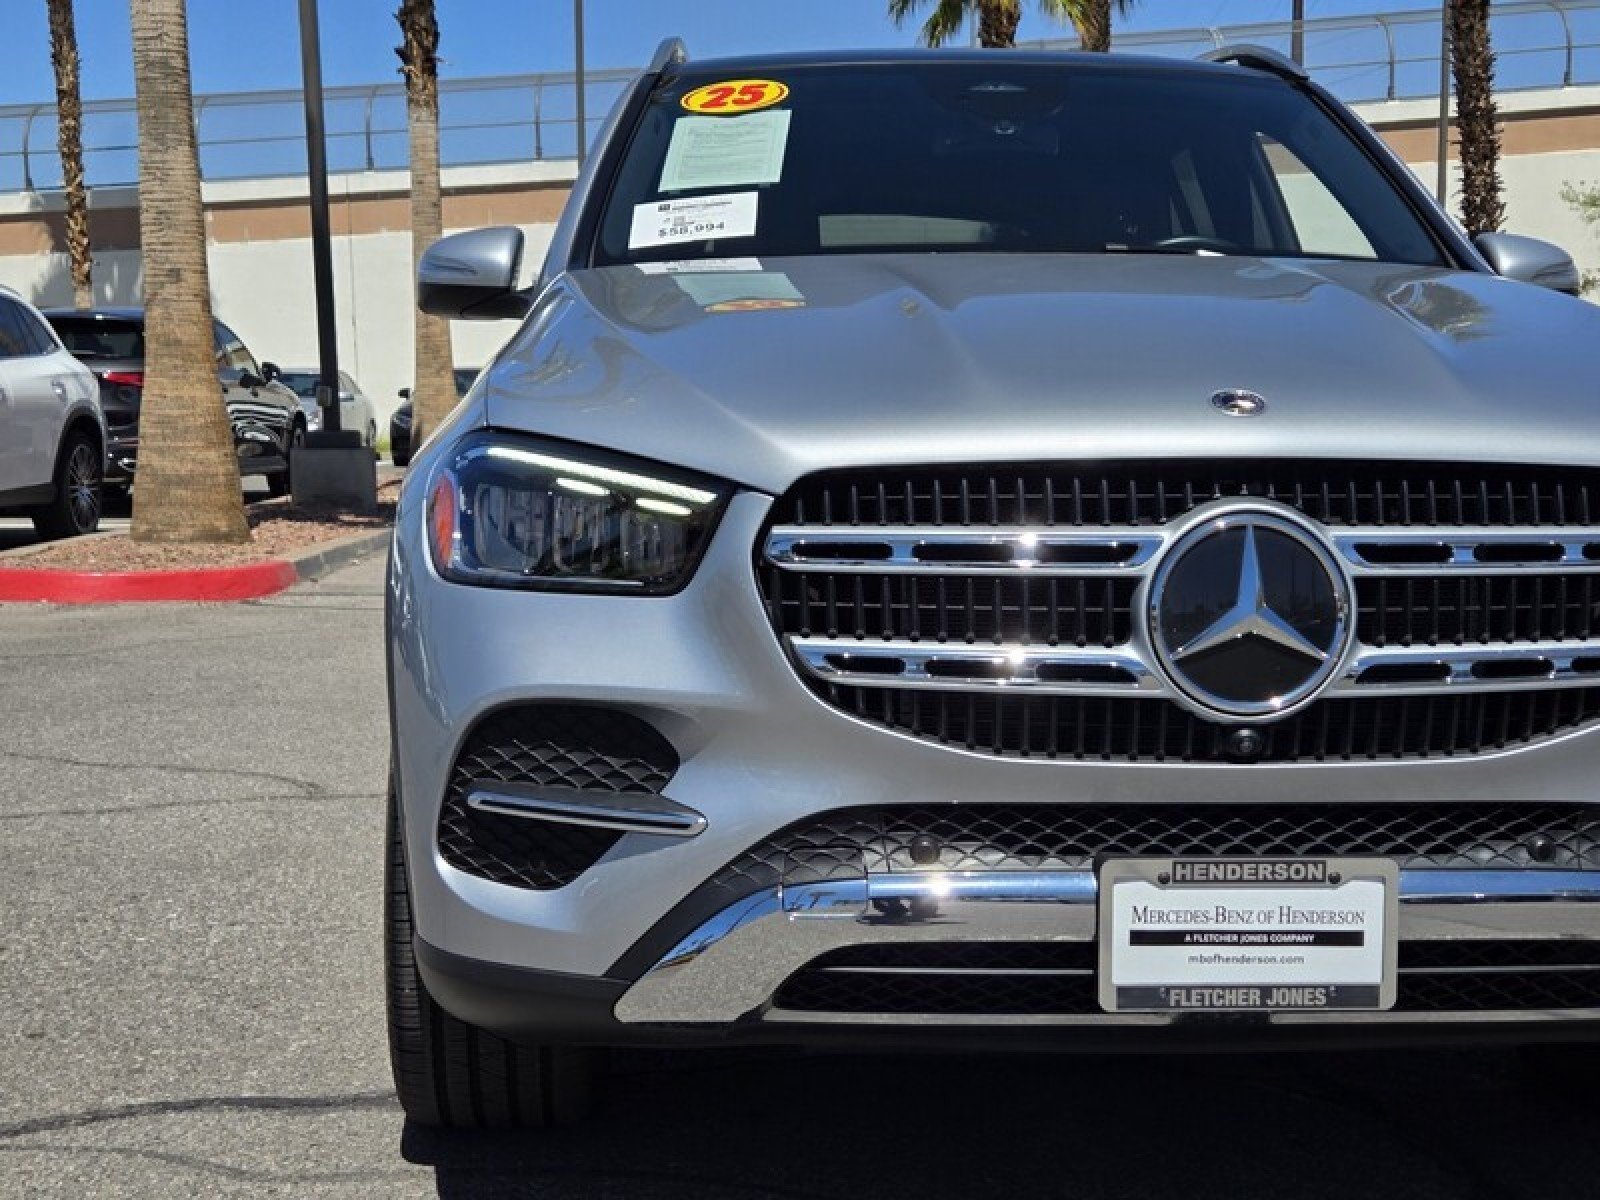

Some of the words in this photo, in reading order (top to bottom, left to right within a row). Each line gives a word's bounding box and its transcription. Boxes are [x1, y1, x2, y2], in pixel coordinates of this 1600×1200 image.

[700, 84, 768, 108] 25
[1175, 863, 1323, 881] HENDERSON
[1131, 906, 1255, 925] MERCEDES-BENZ
[1278, 906, 1365, 925] HENDERSON
[1184, 933, 1192, 943] A
[1193, 933, 1239, 943] FLETCHER
[1240, 933, 1269, 944] JONES
[1269, 933, 1315, 943] COMPANY
[1187, 953, 1305, 965] mbofhenderson.com
[1169, 987, 1261, 1007] FLETCHER
[1265, 987, 1327, 1007] JONES
